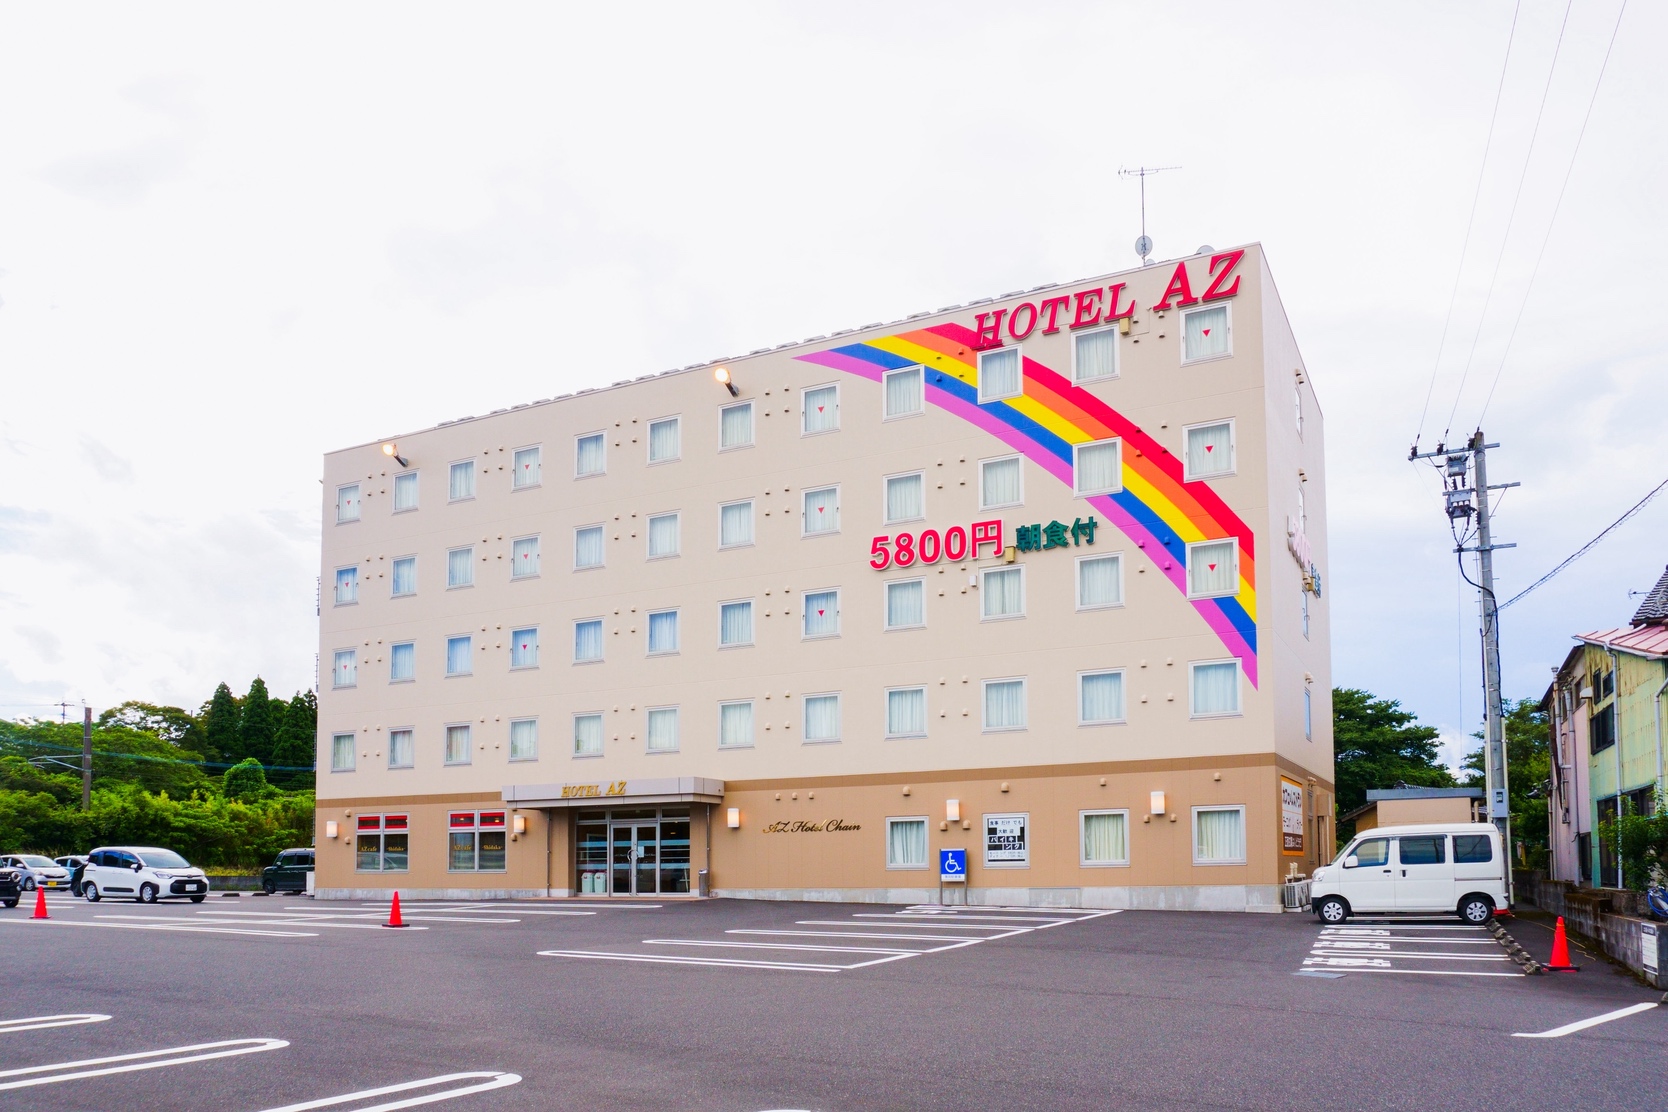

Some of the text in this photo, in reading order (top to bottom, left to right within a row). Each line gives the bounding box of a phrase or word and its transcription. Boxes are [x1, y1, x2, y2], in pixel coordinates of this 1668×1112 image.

[970, 249, 1245, 350] HOTEL AZ
[869, 516, 1098, 571] 5800円 朝食付
[561, 781, 627, 798] HOTEL AZ
[790, 818, 827, 833] Hotel
[826, 819, 862, 833] Chain
